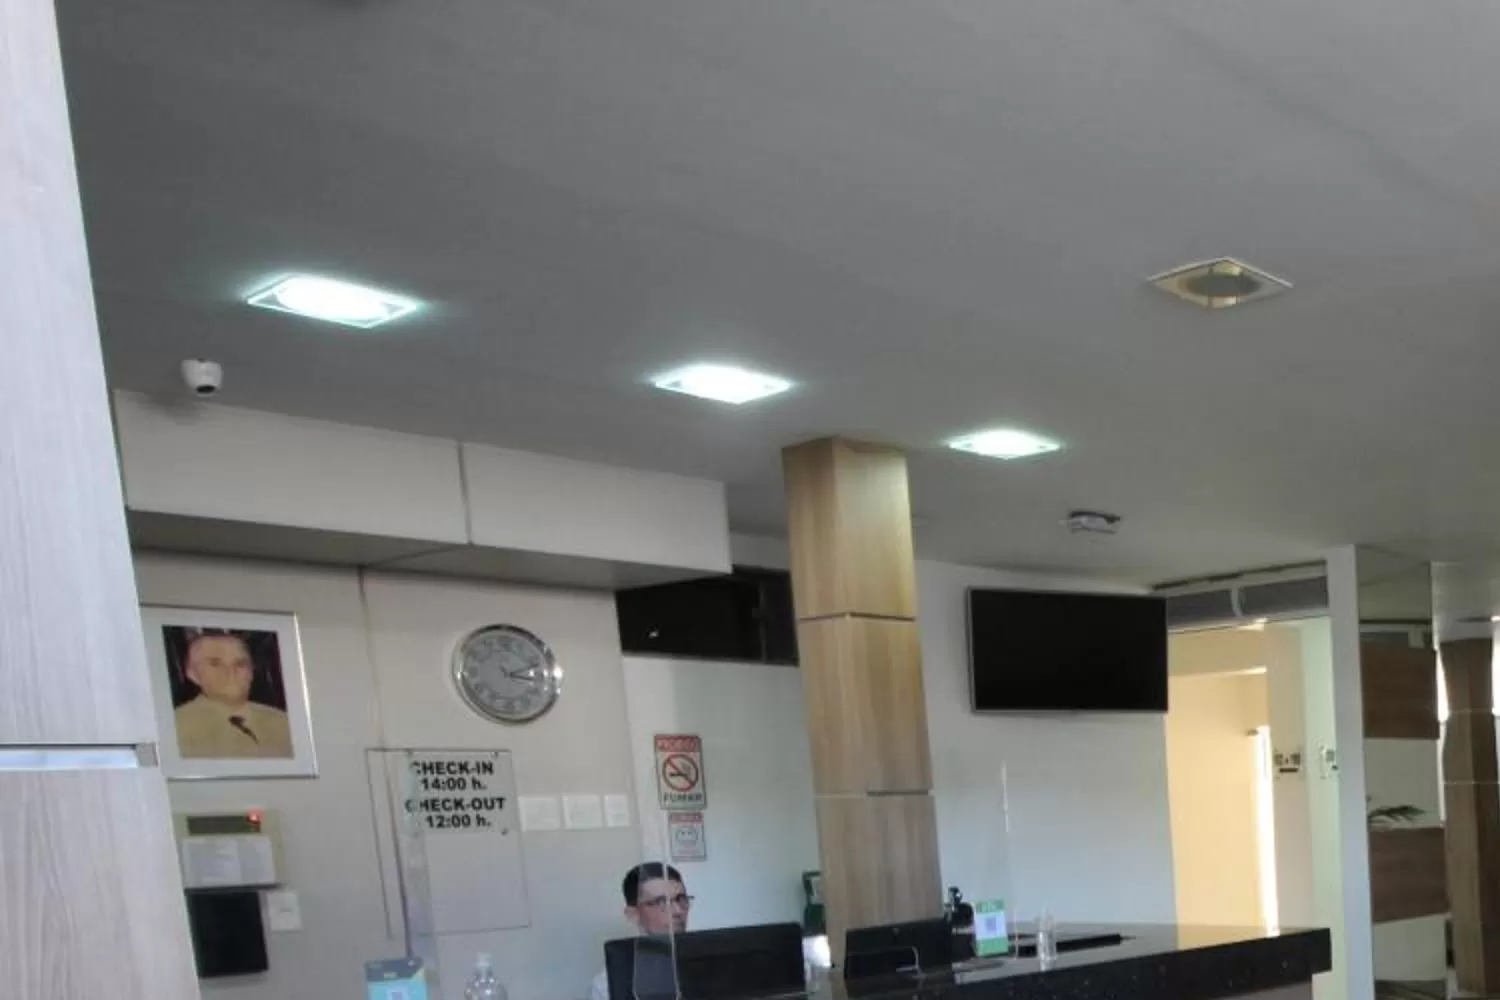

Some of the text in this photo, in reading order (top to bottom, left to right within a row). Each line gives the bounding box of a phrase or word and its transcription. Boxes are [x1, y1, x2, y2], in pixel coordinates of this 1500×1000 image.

[421, 777, 487, 790] 14:00 h.
[405, 797, 505, 812] CHECK-OUT
[426, 814, 491, 828] 12:00 h.
